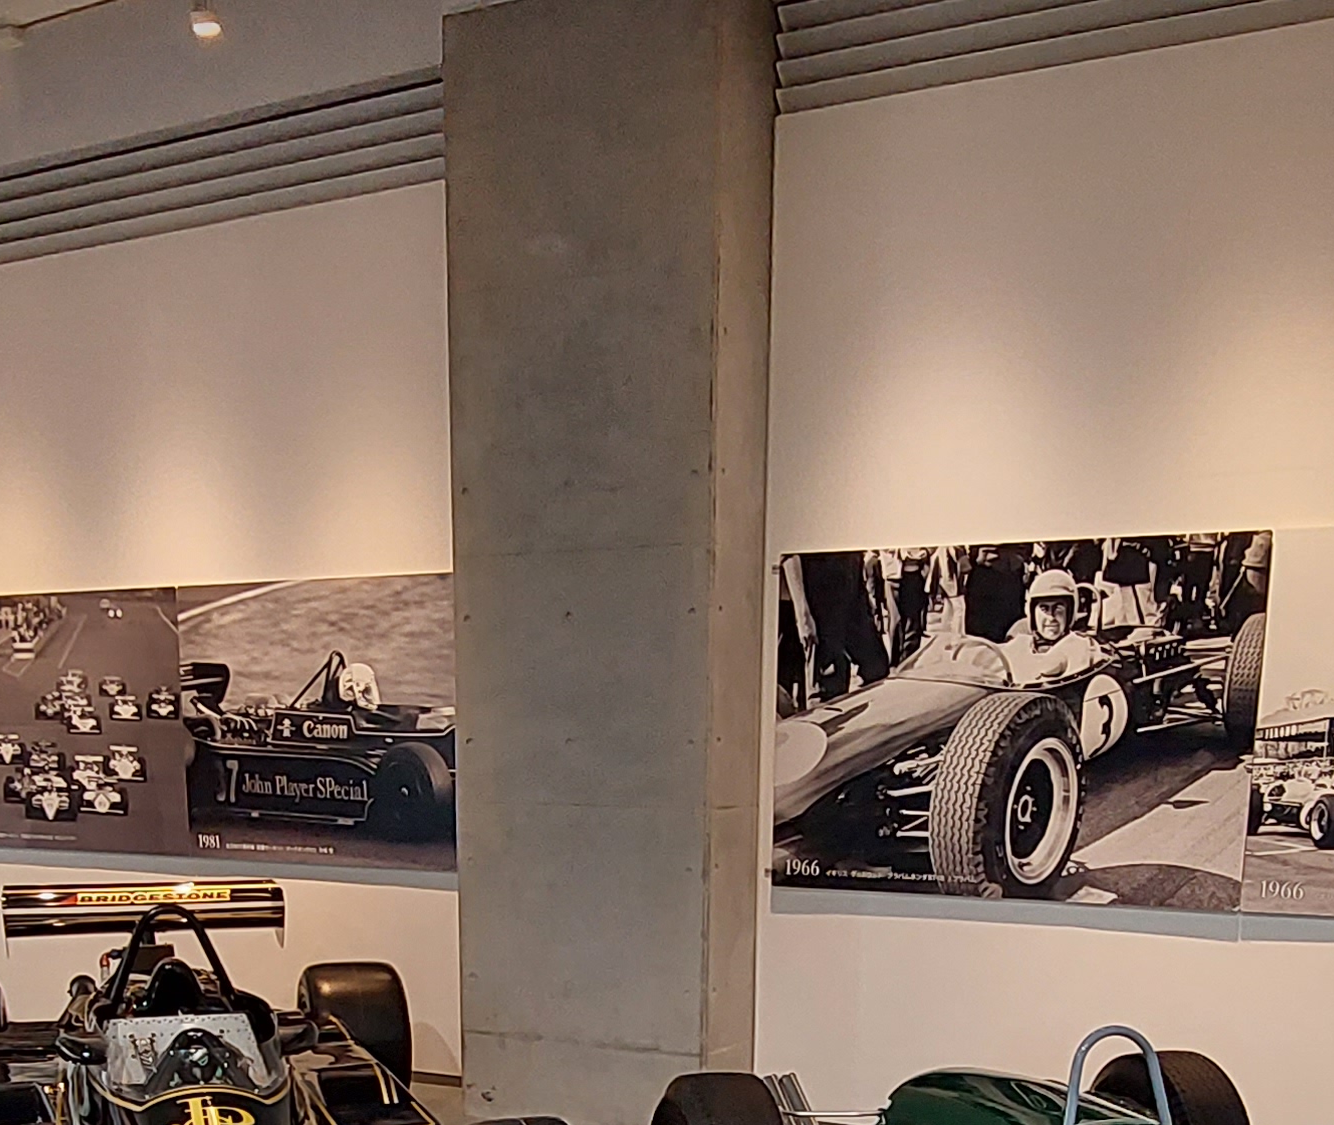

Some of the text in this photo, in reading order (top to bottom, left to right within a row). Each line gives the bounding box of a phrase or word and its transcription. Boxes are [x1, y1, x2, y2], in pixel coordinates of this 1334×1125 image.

[303, 720, 348, 739] Canon
[242, 773, 272, 795] John
[275, 775, 315, 803] Player
[198, 834, 220, 849] 1981
[786, 858, 820, 876] 1966
[79, 890, 230, 904] BRIDGESTONE
[1259, 880, 1306, 900] 1966
